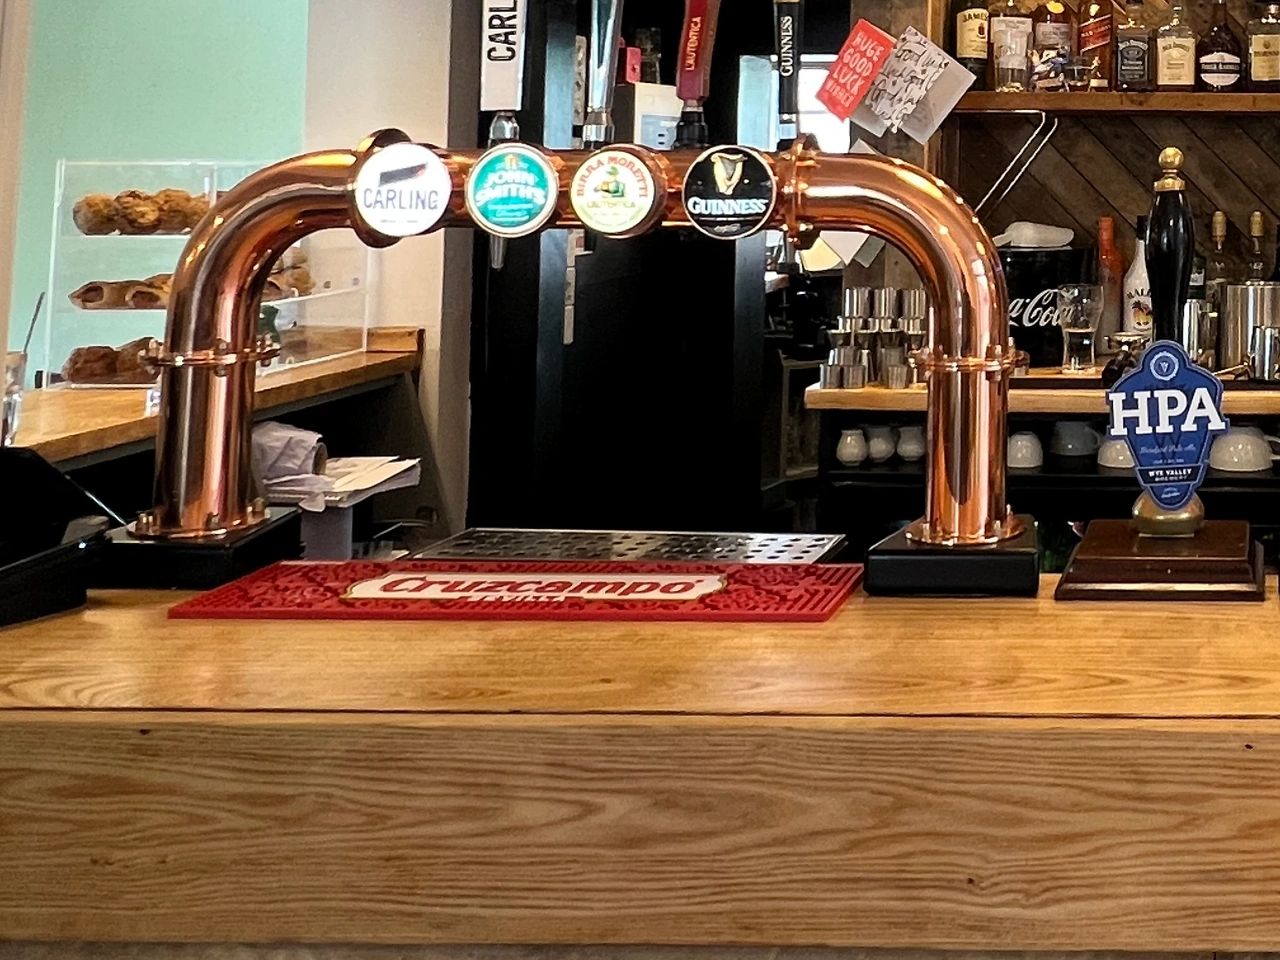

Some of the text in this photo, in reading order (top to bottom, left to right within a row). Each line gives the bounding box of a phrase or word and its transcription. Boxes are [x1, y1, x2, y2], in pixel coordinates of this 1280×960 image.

[780, 16, 793, 77] GUINNESS
[852, 30, 886, 62] HUGE
[842, 47, 874, 77] GOOD
[832, 64, 865, 96] LUCK
[483, 170, 539, 188] JOHN
[576, 159, 603, 197] BIRRA
[606, 156, 649, 198] MORETTI
[363, 187, 439, 210] CARLING
[475, 183, 546, 207] SMITH'S
[687, 196, 769, 216] GUINNESS
[1108, 387, 1227, 436] HPA
[1165, 468, 1193, 476] VALLEY
[378, 576, 704, 597] Cruzcampo
